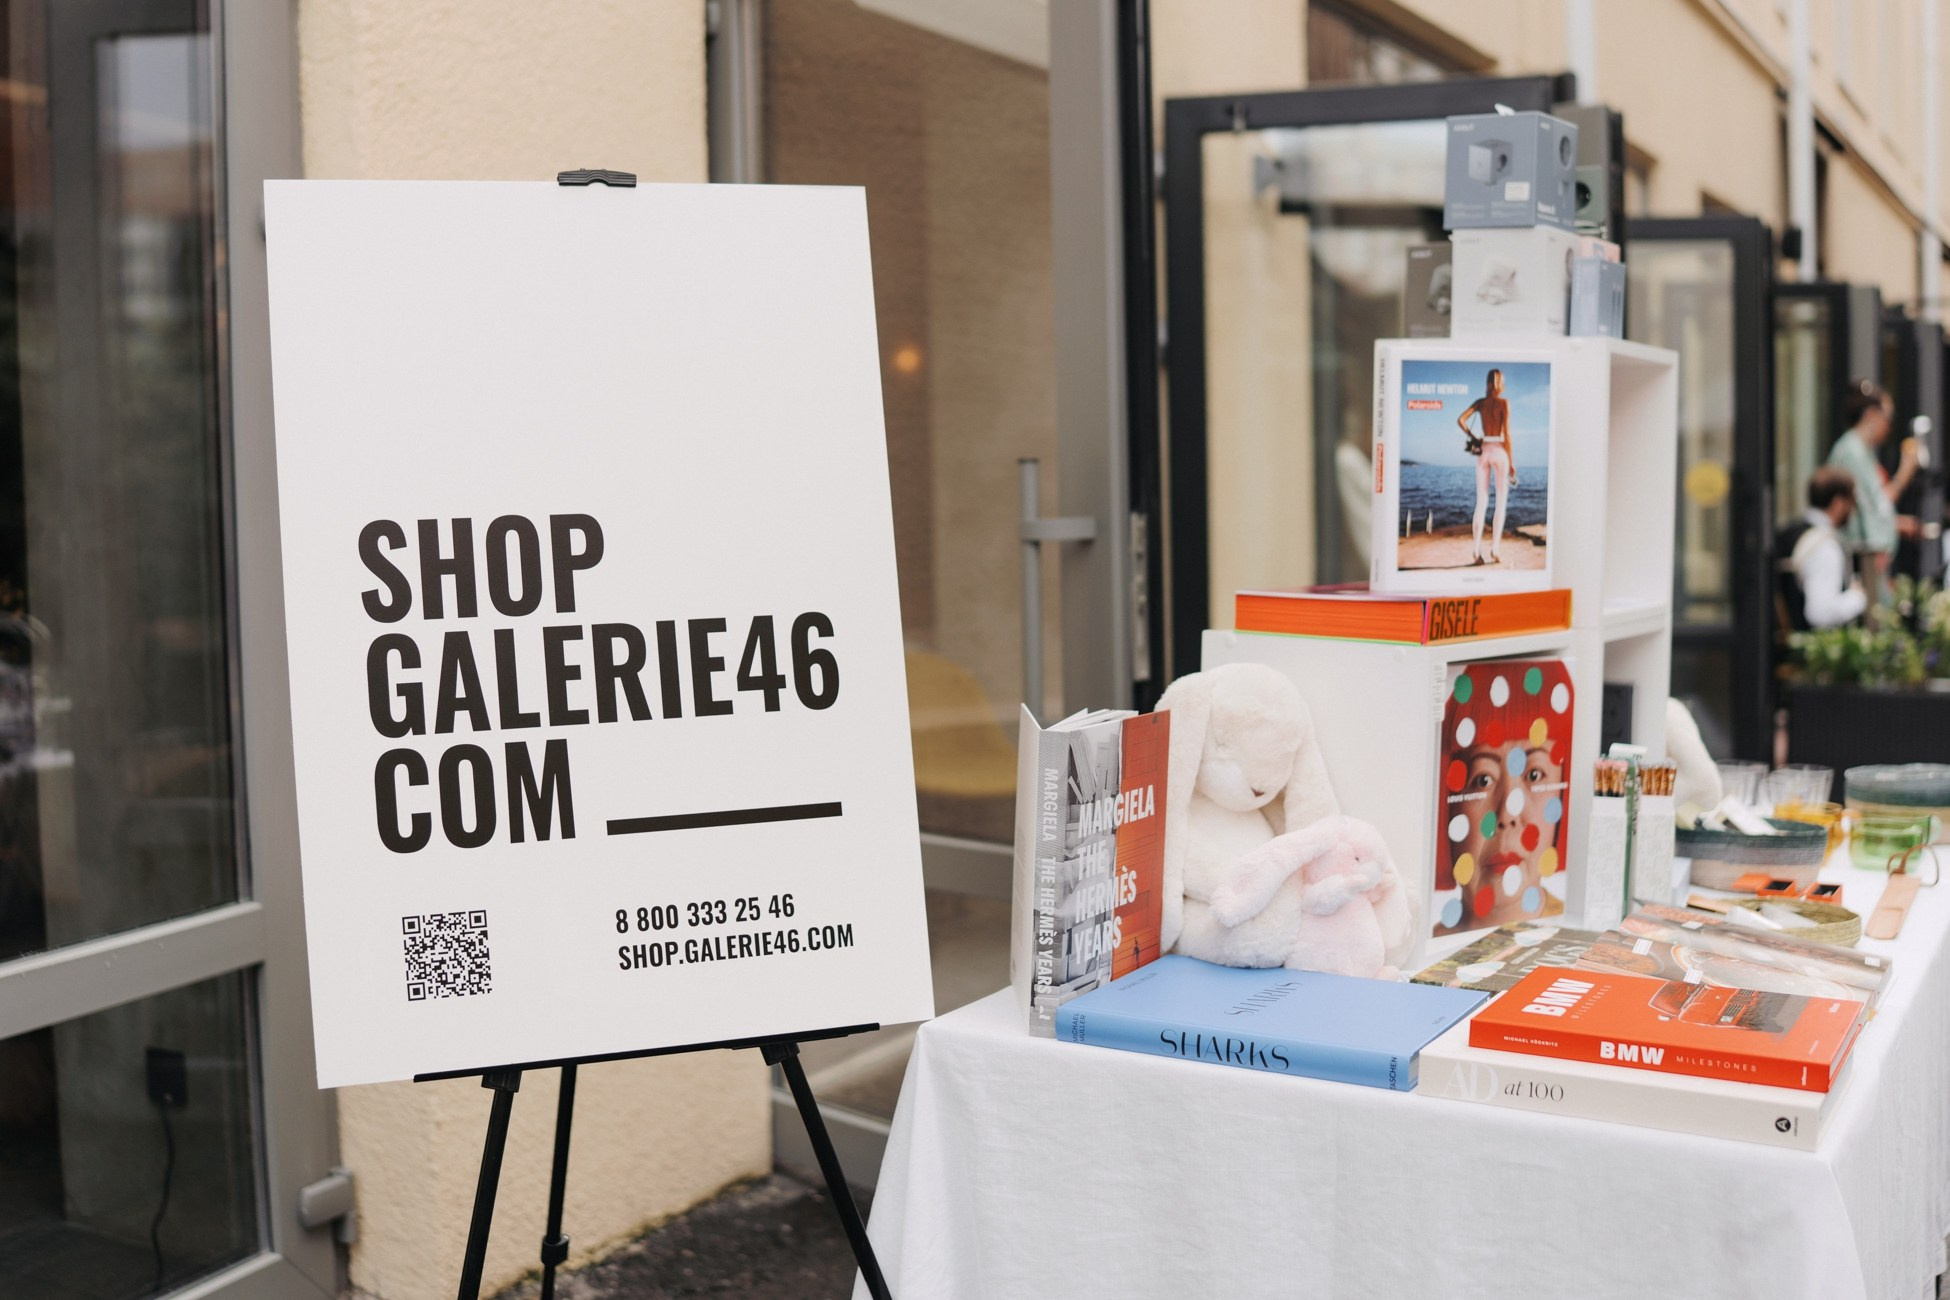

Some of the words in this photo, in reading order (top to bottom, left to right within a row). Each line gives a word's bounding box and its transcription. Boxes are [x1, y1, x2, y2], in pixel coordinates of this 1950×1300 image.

[358, 513, 605, 624] SHOP
[1429, 599, 1481, 641] GISELE
[366, 611, 841, 739] GALERIE46
[374, 738, 577, 854] COM
[1043, 767, 1059, 842] MARGIELA
[1078, 784, 1155, 838] MARGIELA
[1041, 856, 1056, 884] THE
[1078, 839, 1107, 881] THE
[615, 909, 629, 934] 8
[636, 904, 679, 932] 800
[686, 899, 728, 927] 333
[734, 896, 761, 923] 25
[768, 893, 795, 919] 46
[1039, 887, 1058, 945] HERMÈS
[1075, 865, 1137, 924] HERMÈS
[618, 923, 854, 971] SHOP.GALERIE46.COM
[1074, 915, 1123, 965] YEARS
[1037, 949, 1053, 994] YEARS
[1223, 982, 1302, 1016] SHARKS
[1521, 977, 1595, 1017] BMW
[1160, 1028, 1290, 1071] SHARKS
[1503, 1035, 1529, 1044] MICHAEL
[1600, 1040, 1664, 1066] BMW
[1676, 1055, 1757, 1073] MILESTONES
[1389, 1056, 1397, 1090] TASCHEN
[1441, 1059, 1499, 1103] AD
[1504, 1080, 1521, 1096] at
[1528, 1081, 1564, 1102] 100
